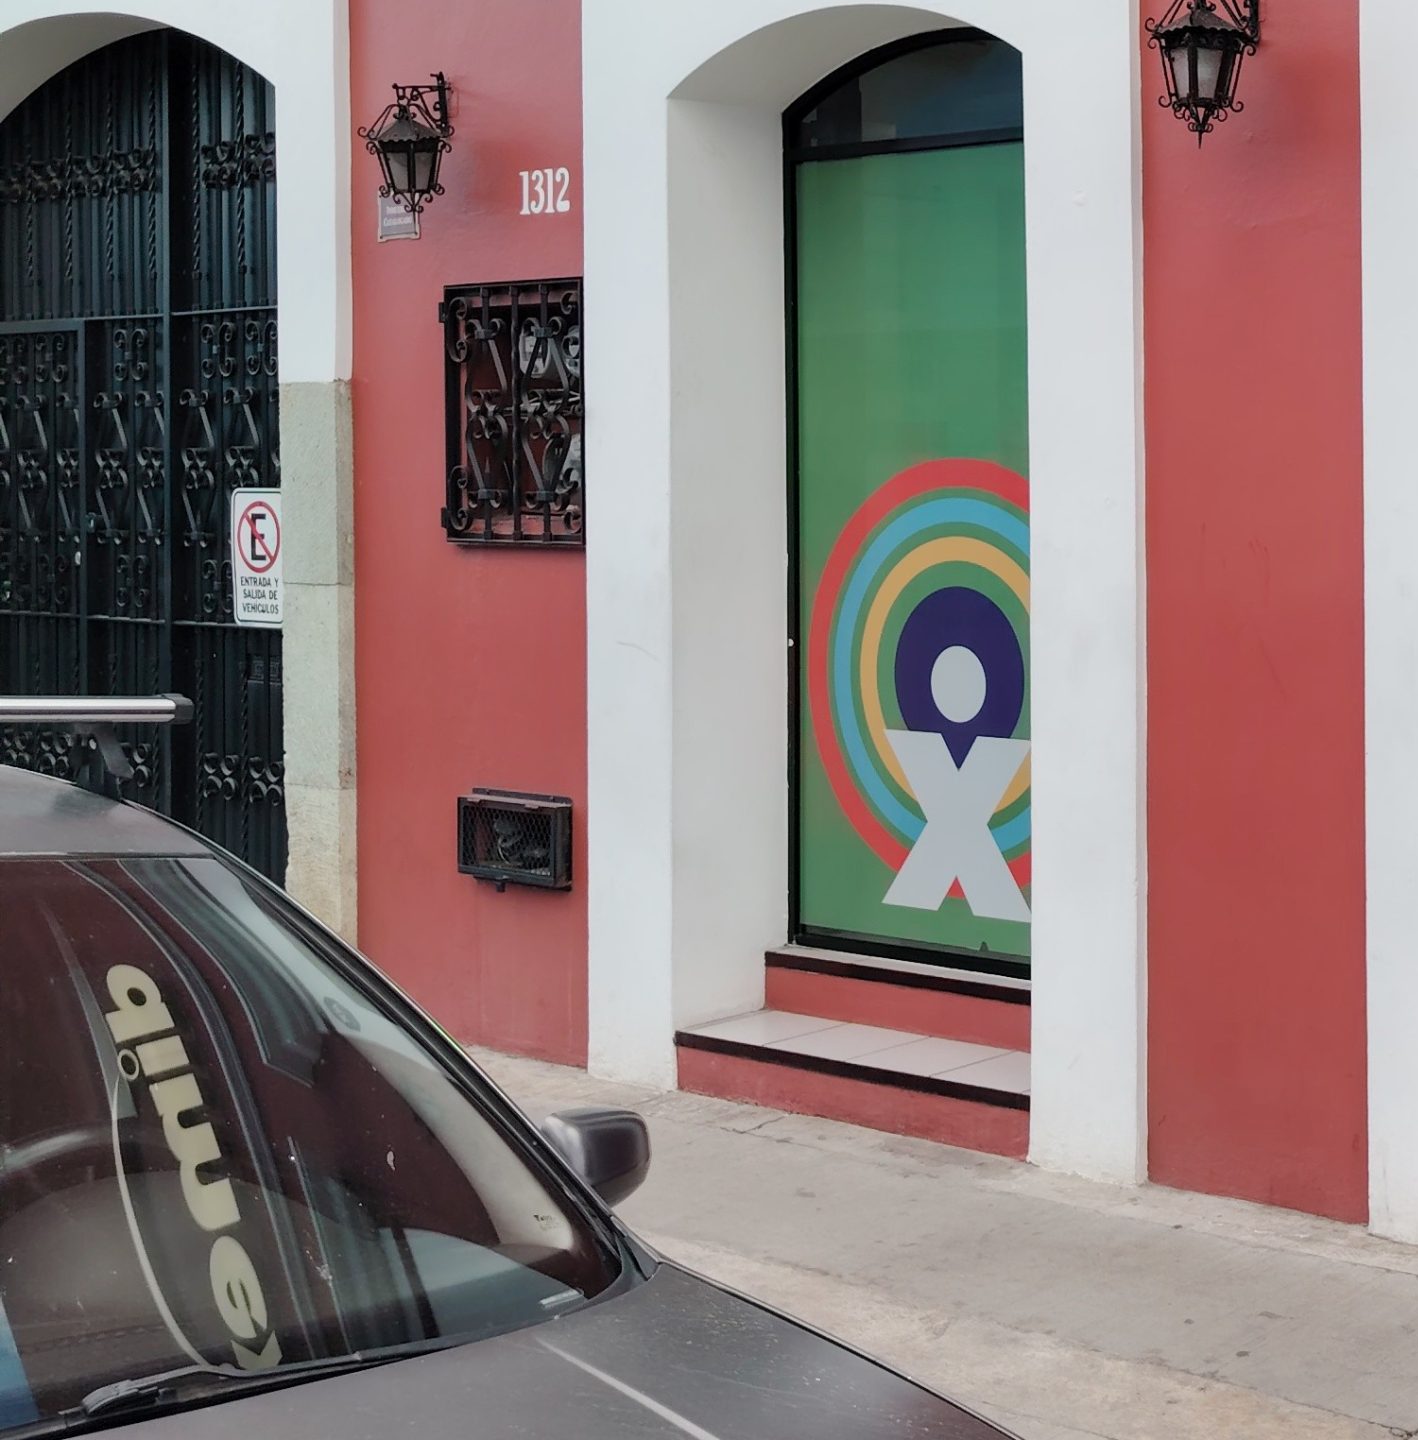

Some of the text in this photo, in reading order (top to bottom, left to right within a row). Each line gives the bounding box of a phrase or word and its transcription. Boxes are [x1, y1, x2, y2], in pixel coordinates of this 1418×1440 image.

[519, 167, 571, 216] 1312
[240, 576, 279, 588] ENTRADA Y
[242, 588, 278, 601] SALIDA DE
